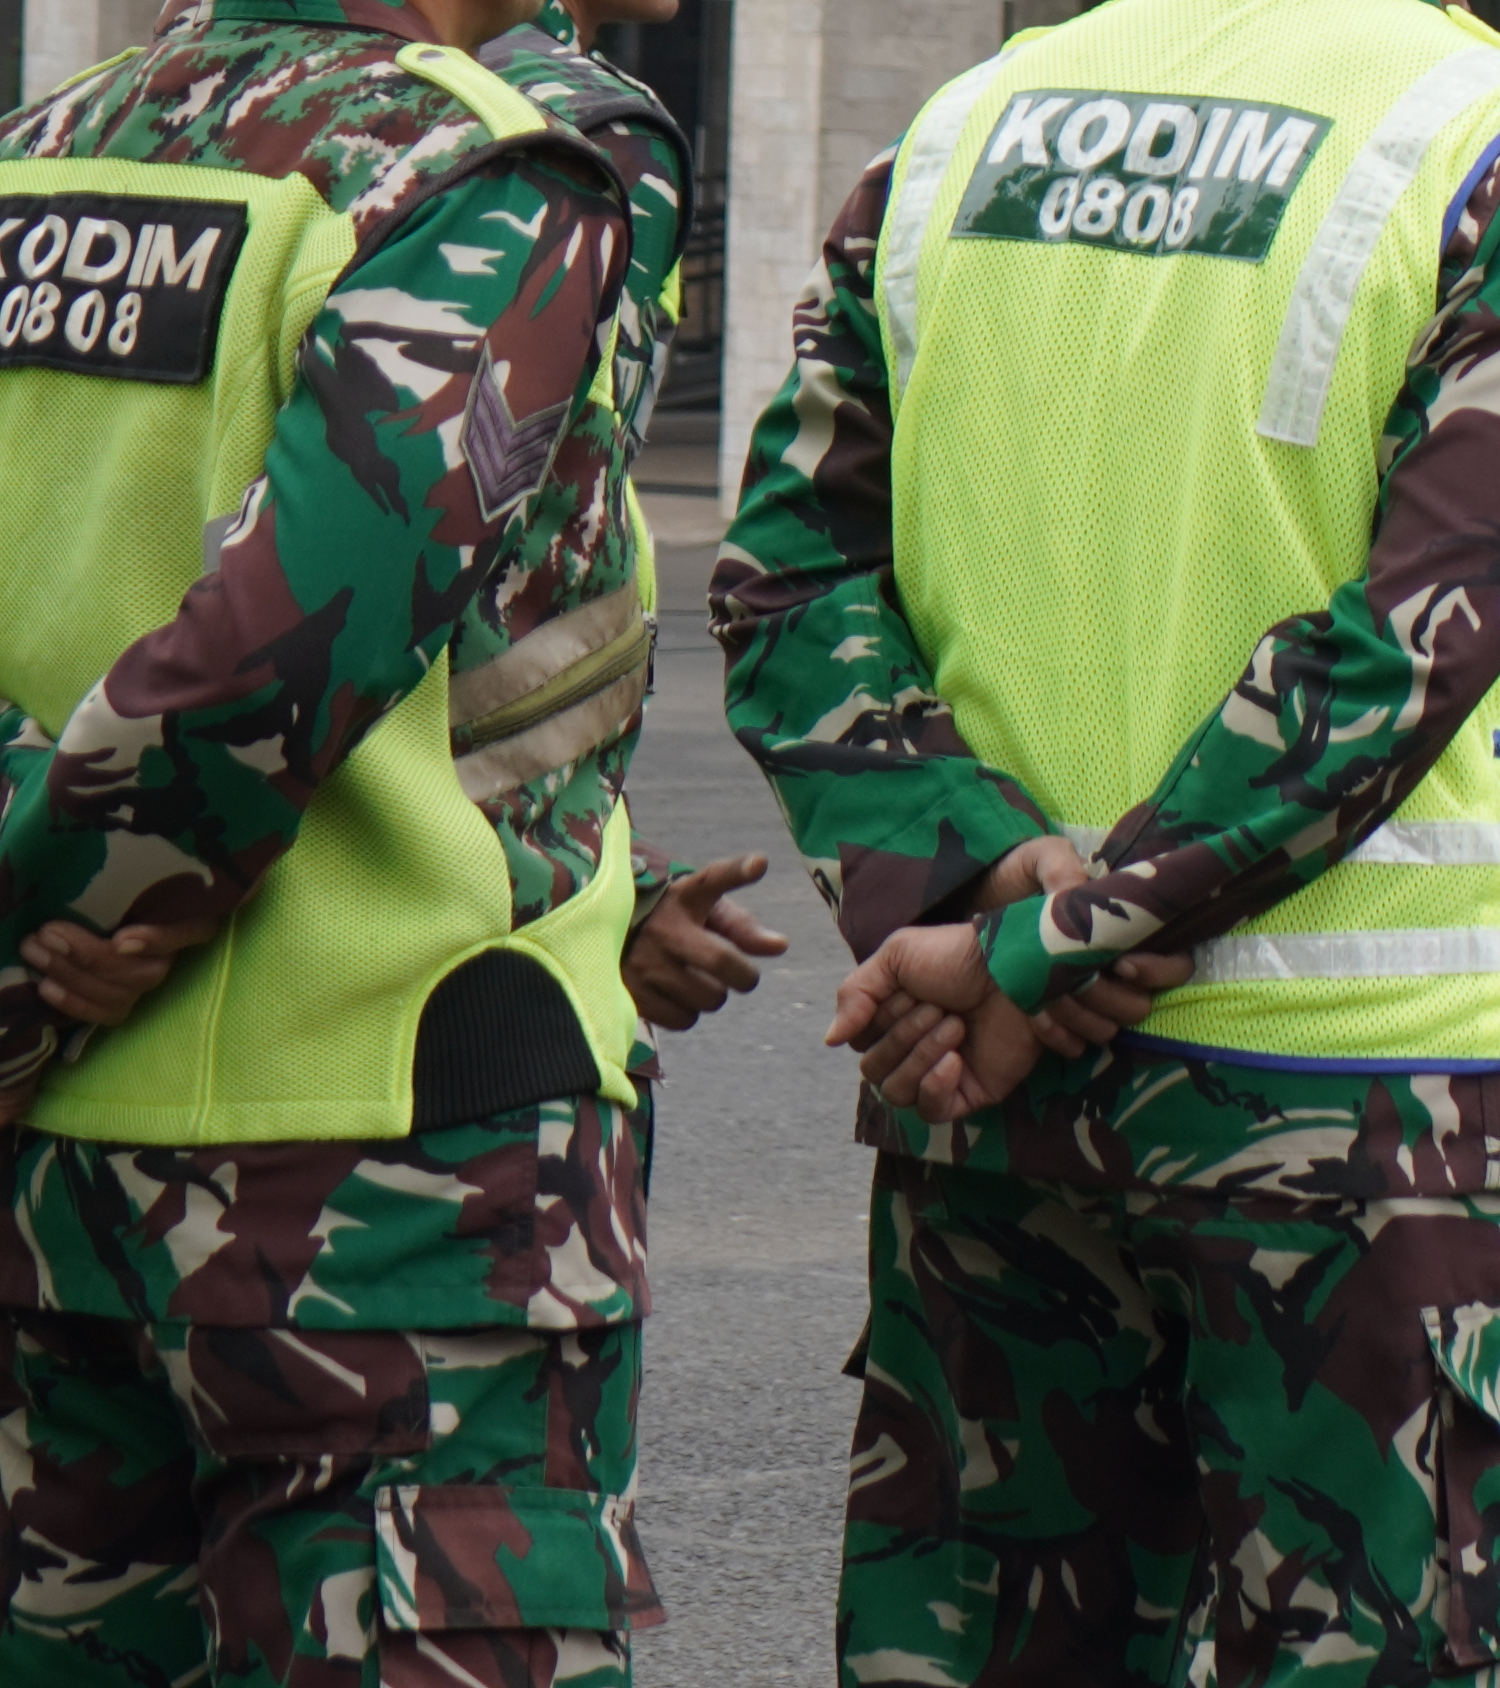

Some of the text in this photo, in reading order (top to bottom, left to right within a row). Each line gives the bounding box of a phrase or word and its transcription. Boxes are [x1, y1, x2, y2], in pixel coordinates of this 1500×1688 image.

[986, 97, 1317, 188] KODIM
[1038, 176, 1200, 246] 0808
[0, 281, 141, 356] 0808
